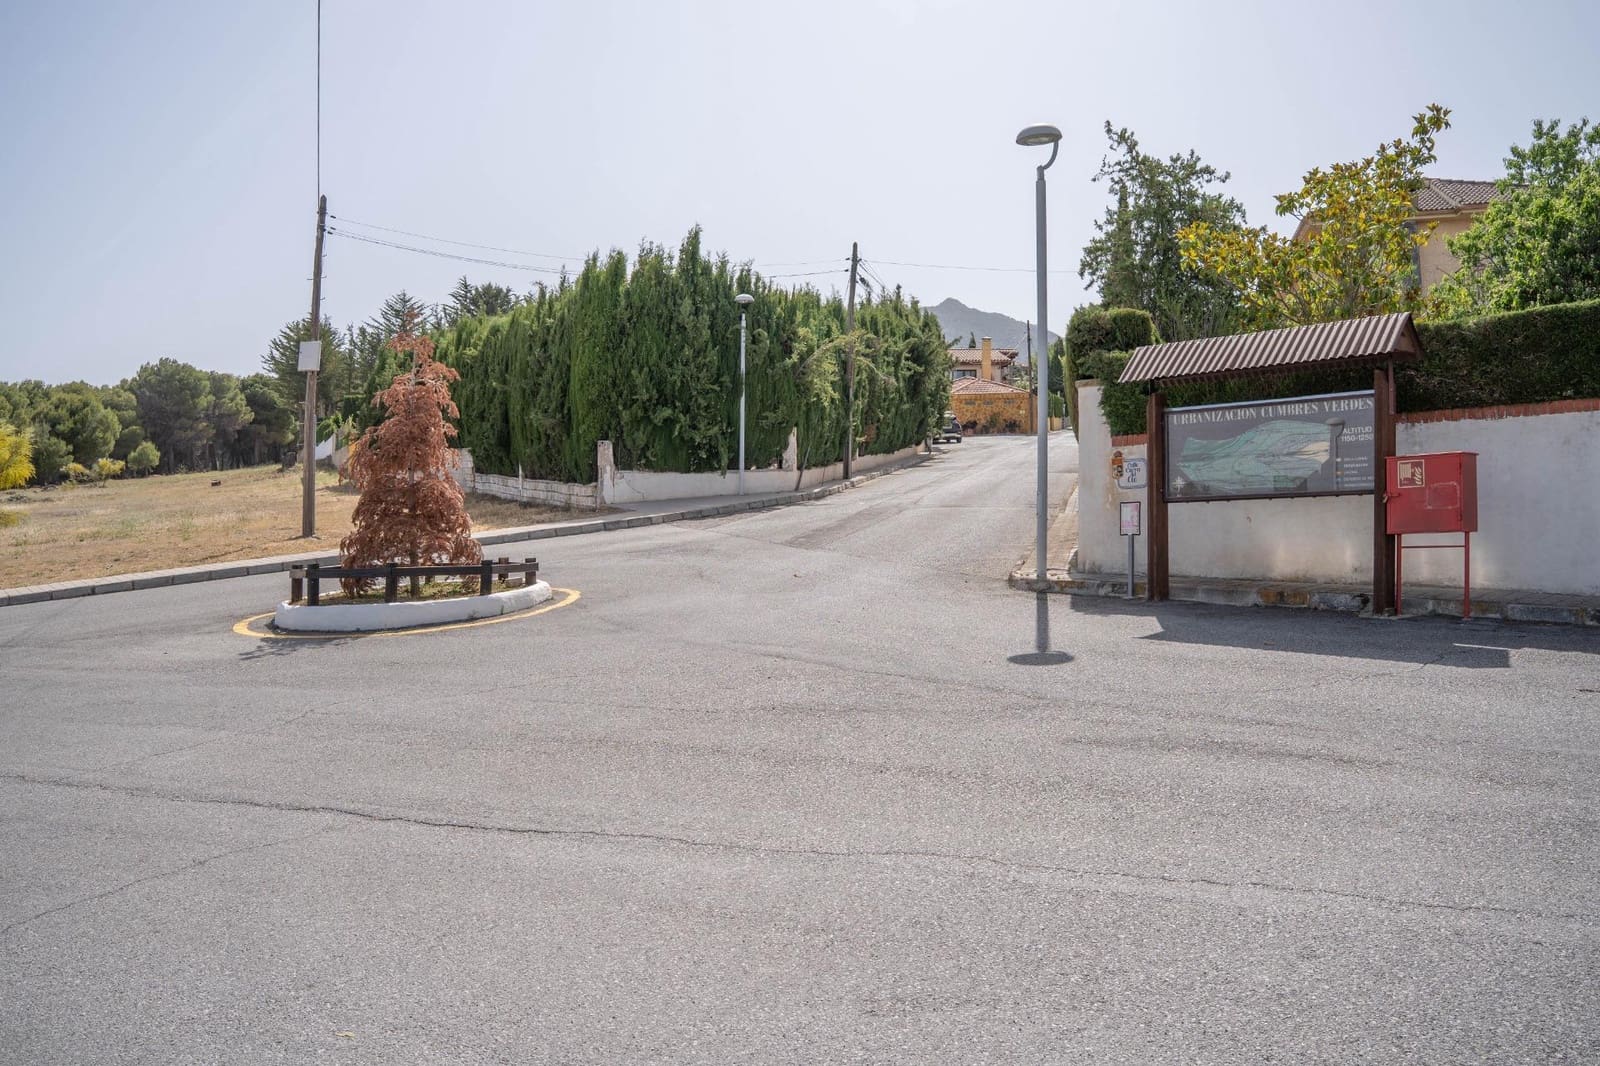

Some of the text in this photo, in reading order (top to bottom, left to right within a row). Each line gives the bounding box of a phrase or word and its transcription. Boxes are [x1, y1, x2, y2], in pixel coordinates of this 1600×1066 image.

[1173, 398, 1374, 425] URBANIZACION CUMBRES VERDES
[1342, 426, 1372, 435] ALTITUD
